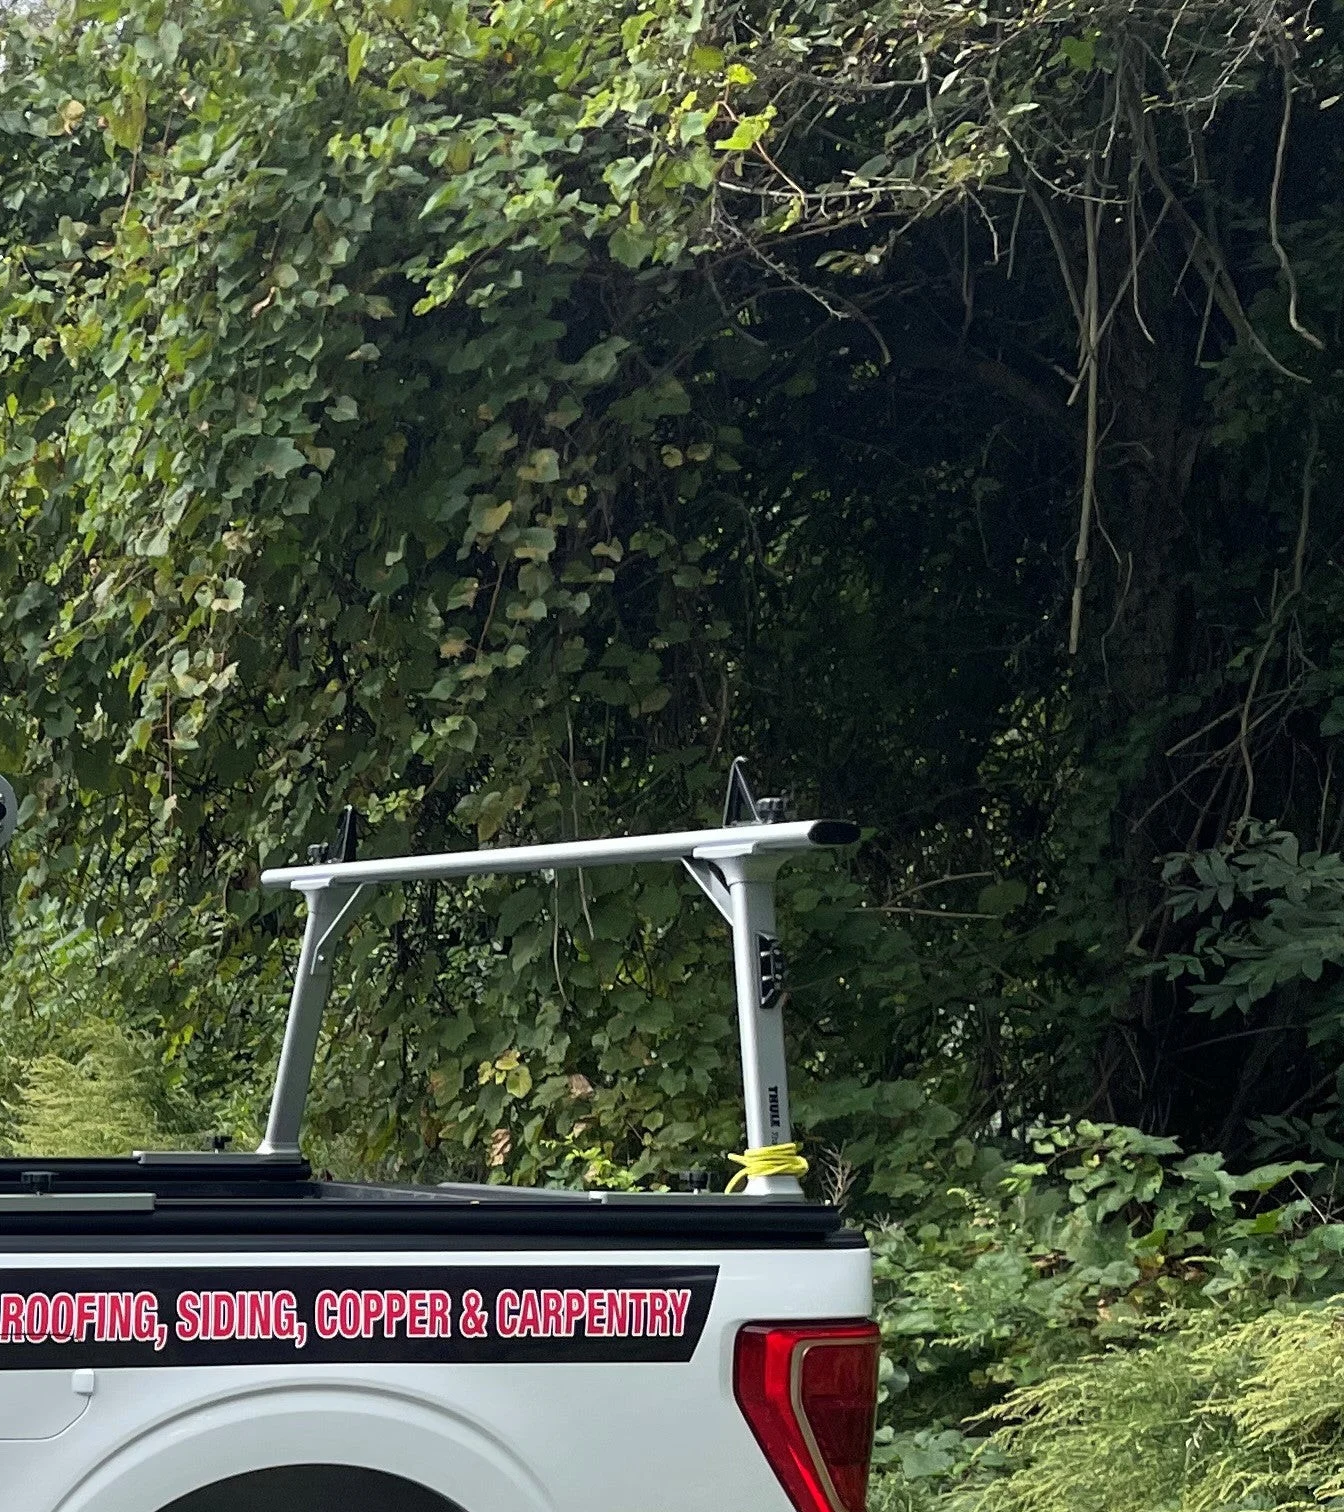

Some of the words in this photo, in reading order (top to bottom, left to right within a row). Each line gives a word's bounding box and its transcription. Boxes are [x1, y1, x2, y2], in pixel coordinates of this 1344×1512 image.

[768, 1086, 780, 1127] THULE
[0, 1294, 168, 1348] ROOFING,
[176, 1292, 308, 1347] SIDING,
[316, 1291, 450, 1338] COPPER
[460, 1291, 487, 1337] &
[497, 1290, 691, 1337] CARPENTRY
